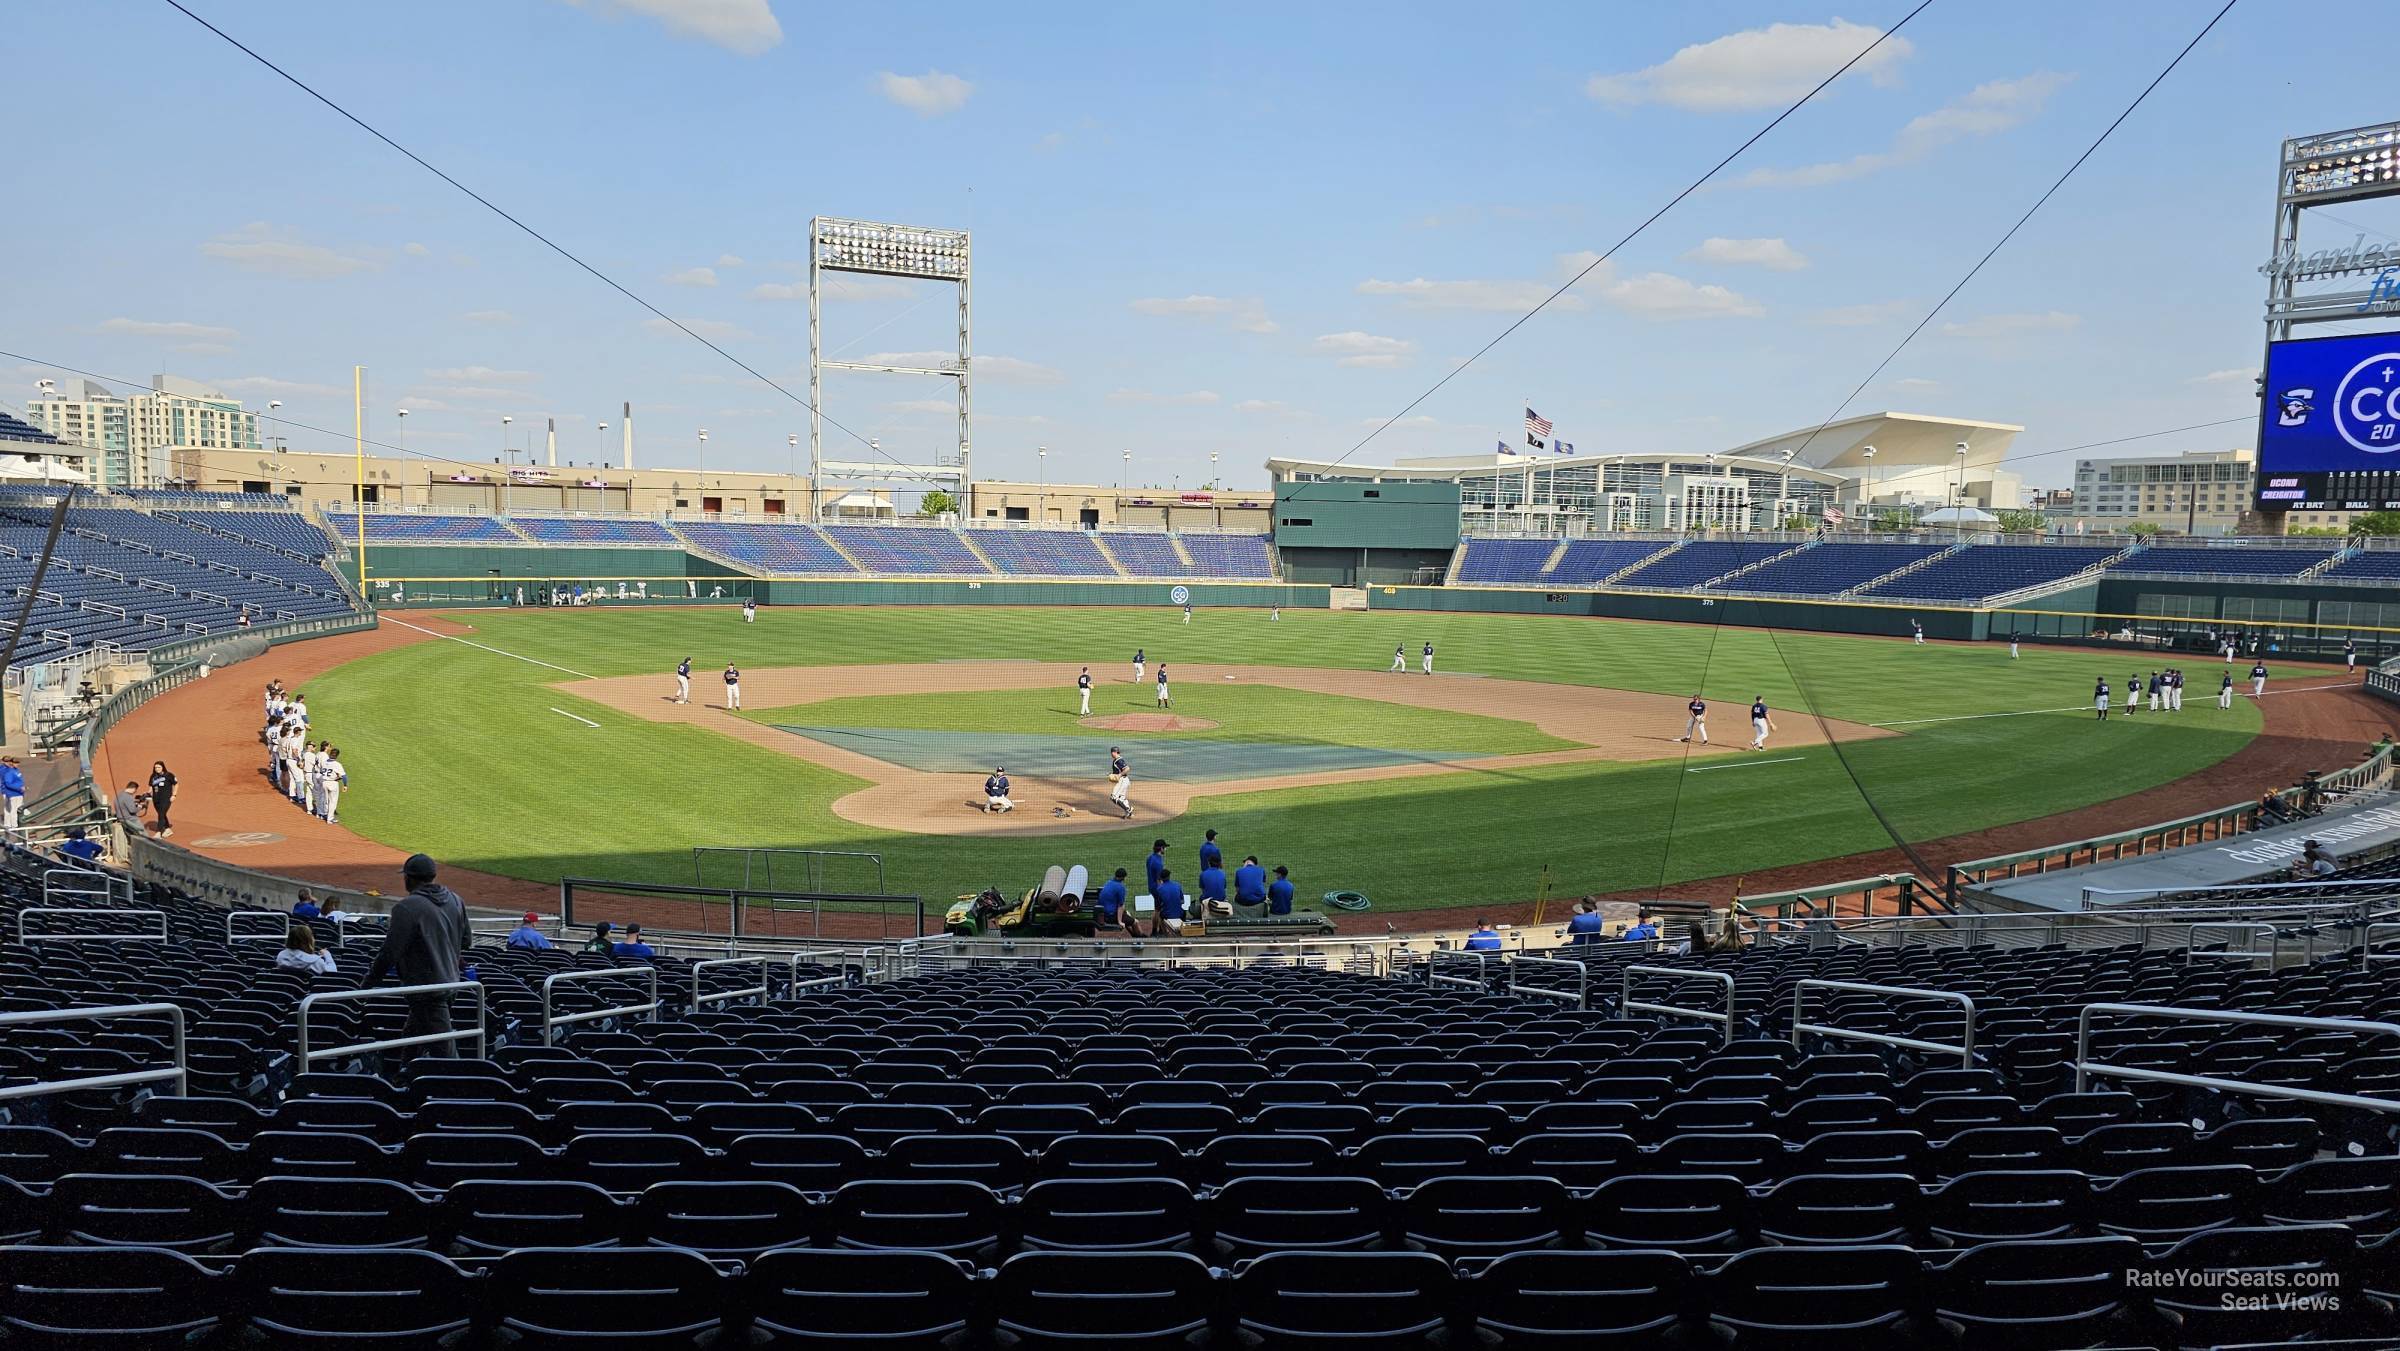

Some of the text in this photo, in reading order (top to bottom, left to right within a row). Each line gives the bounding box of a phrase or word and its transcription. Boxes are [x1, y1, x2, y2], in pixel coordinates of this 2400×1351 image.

[2269, 479, 2299, 487] UCONN
[2261, 490, 2305, 499] CREIGHTON
[375, 580, 390, 588] 335
[320, 767, 334, 777] 22
